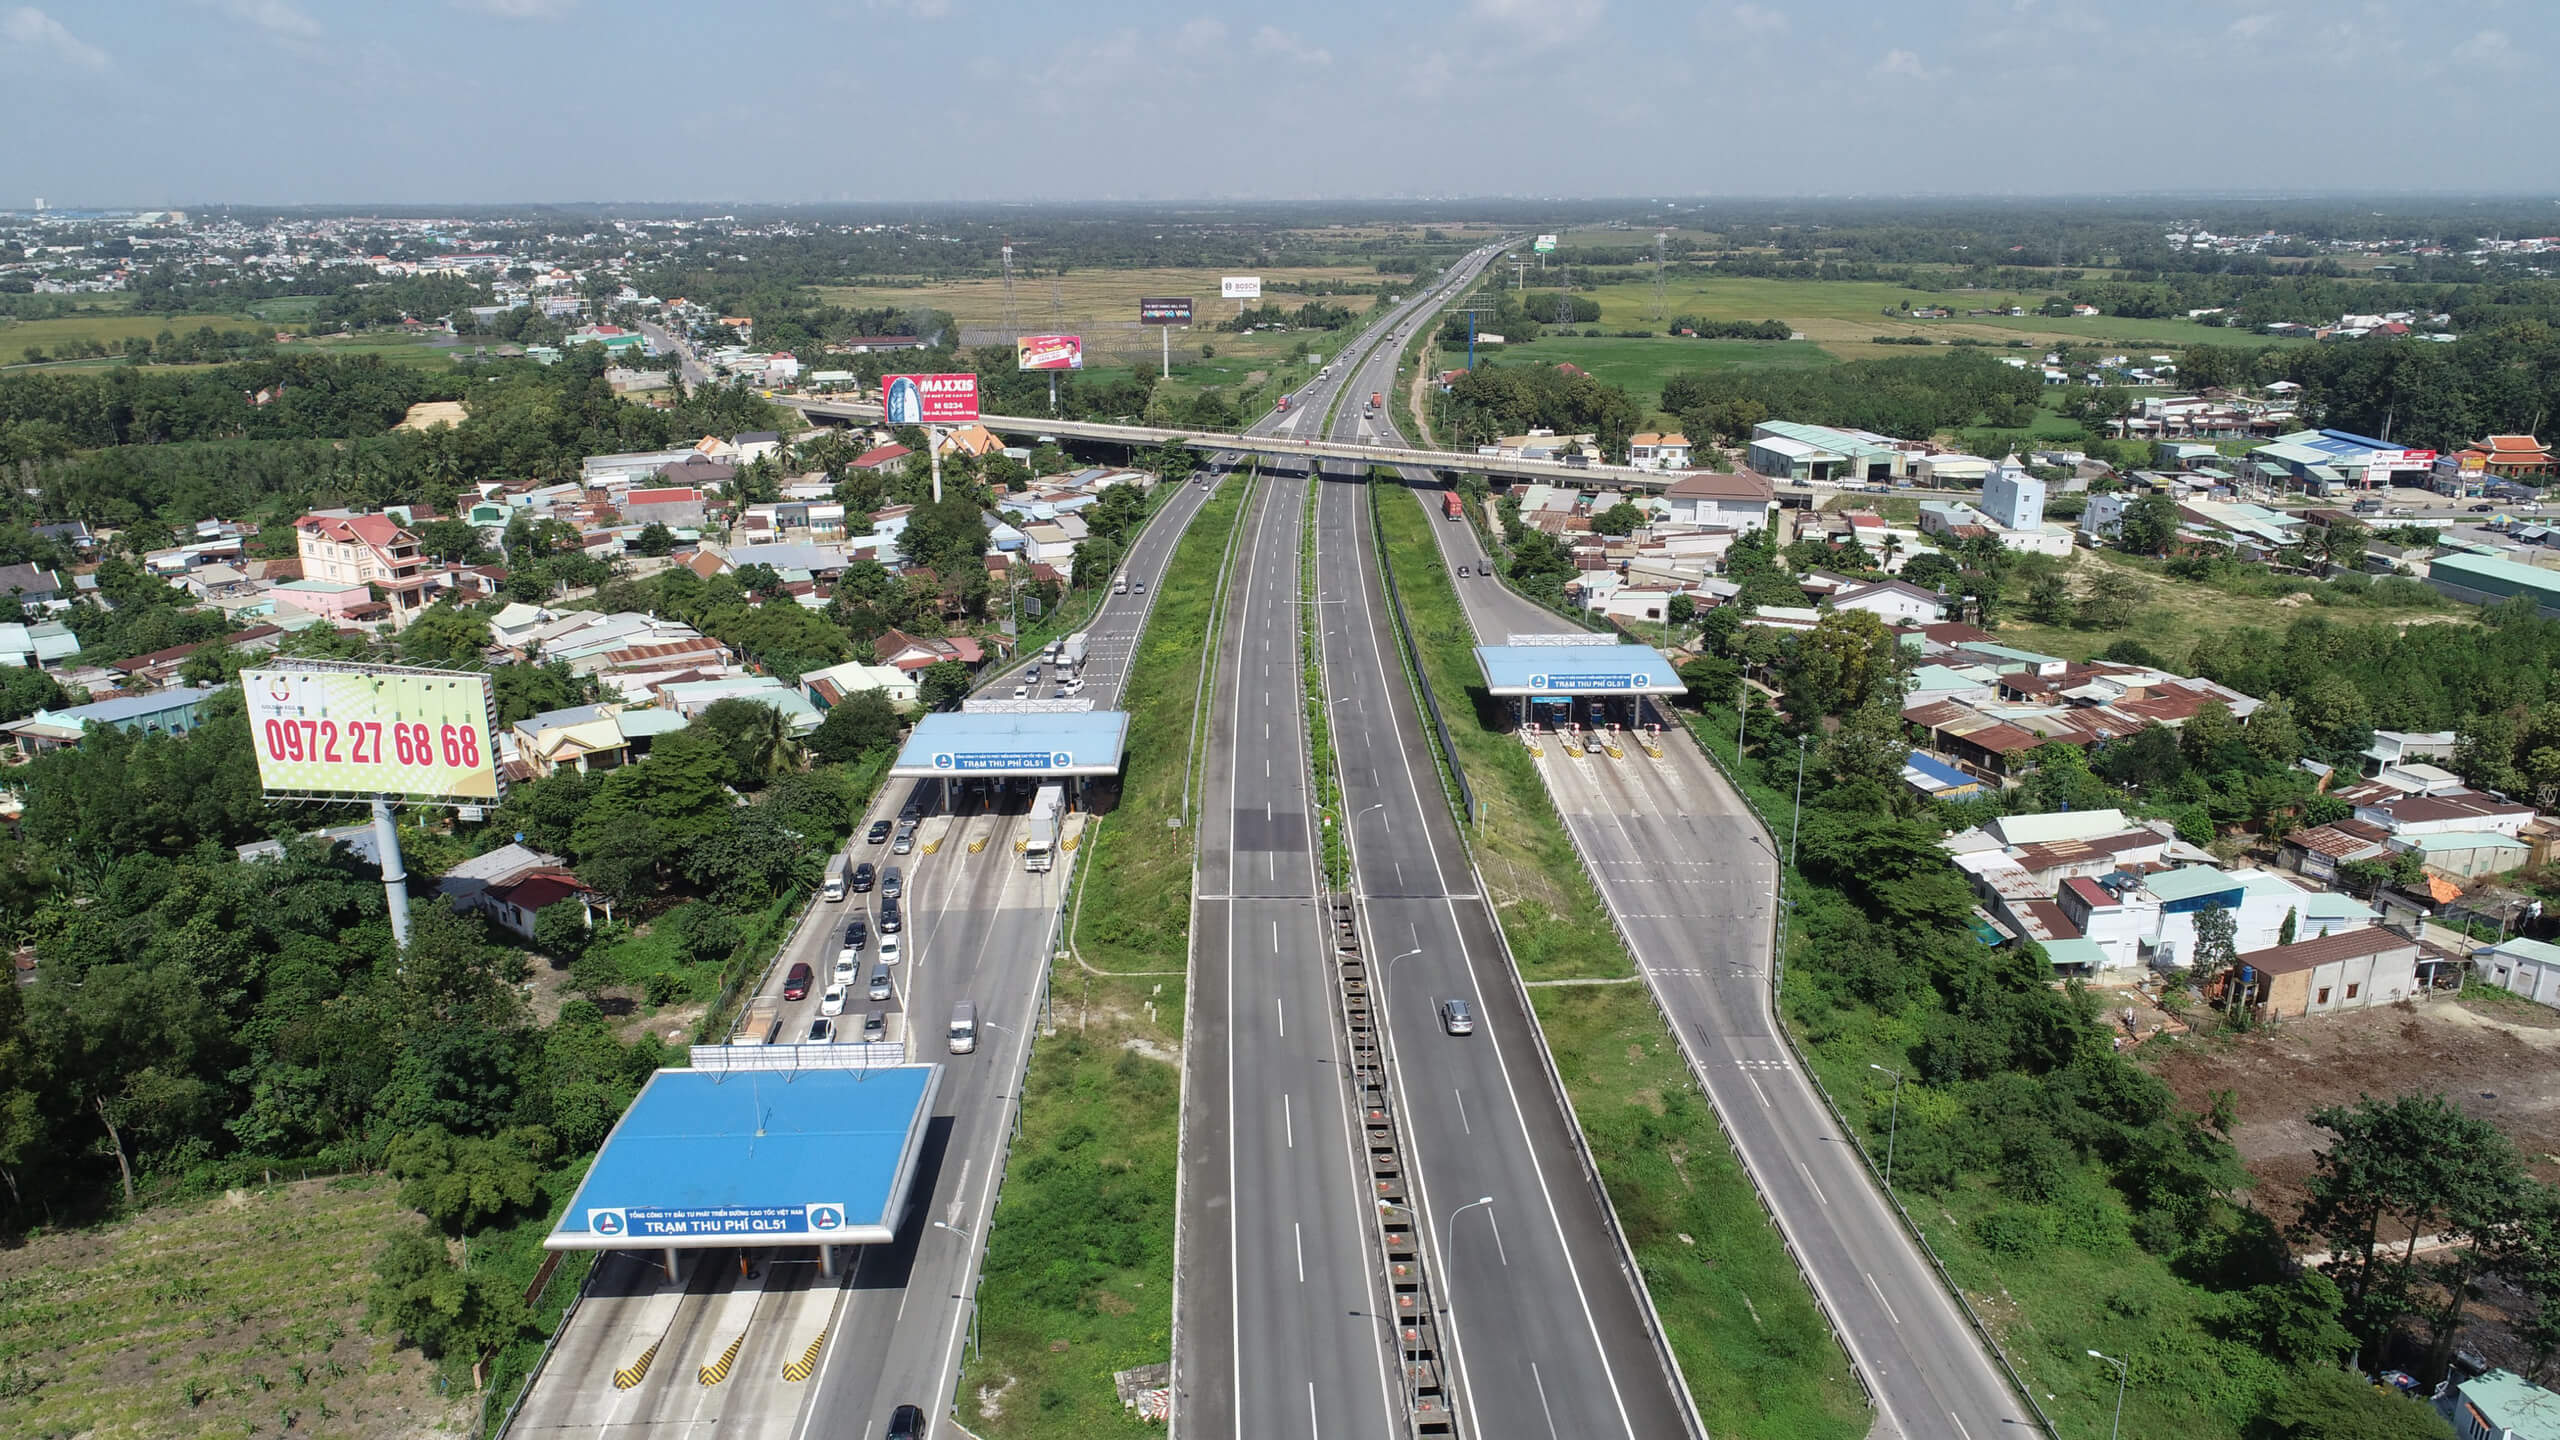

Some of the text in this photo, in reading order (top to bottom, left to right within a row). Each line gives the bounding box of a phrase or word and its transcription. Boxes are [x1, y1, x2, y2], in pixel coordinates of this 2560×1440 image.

[920, 379, 974, 392] MAXXIS
[265, 719, 480, 768] 0972 27 68 68
[963, 760, 987, 769] TRẠM
[988, 759, 1006, 768] THU
[1007, 757, 1023, 768] PHÍ
[644, 1217, 787, 1235] TRẠM THU PHÍ QL51
